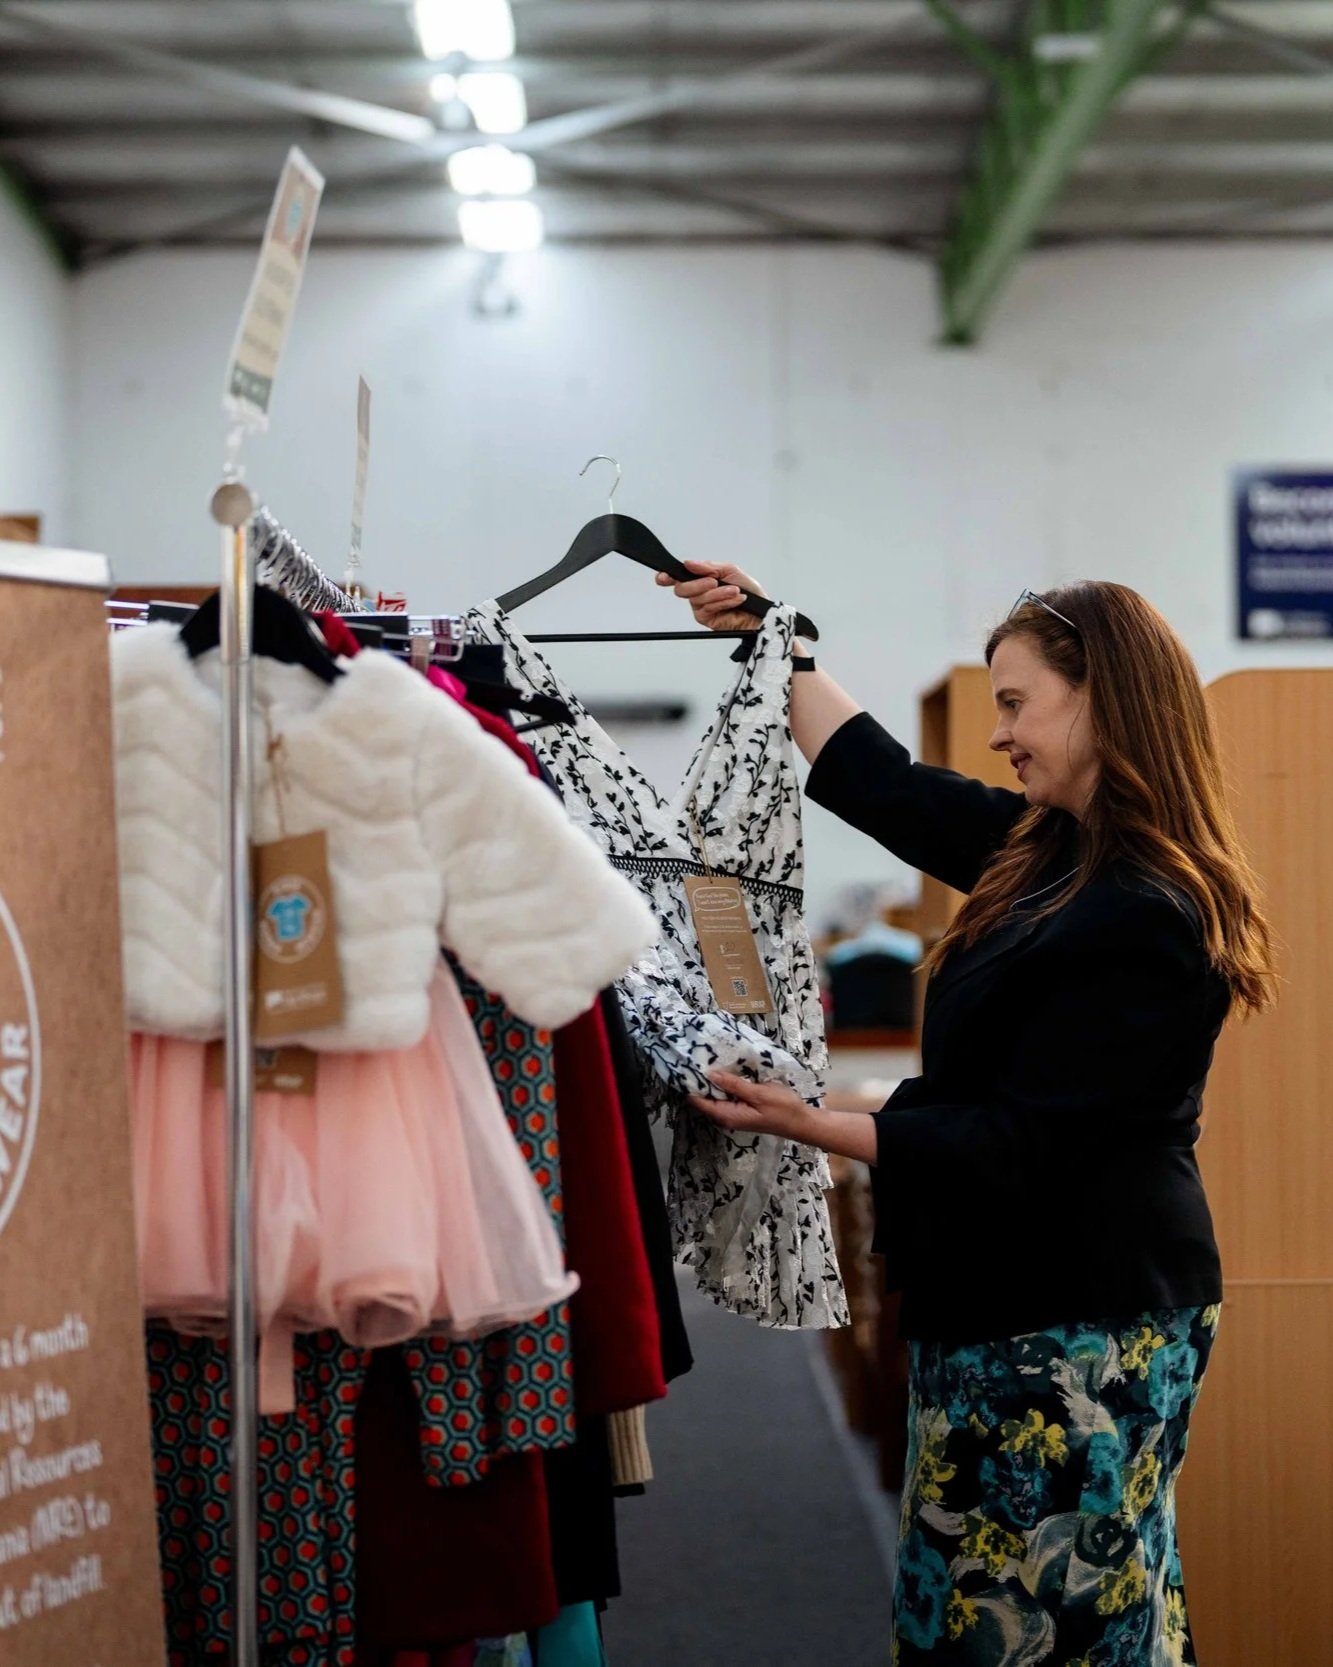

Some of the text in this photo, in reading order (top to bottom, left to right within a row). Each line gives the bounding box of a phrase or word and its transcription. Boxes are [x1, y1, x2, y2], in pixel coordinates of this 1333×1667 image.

[30, 1312, 89, 1360] month
[34, 1380, 70, 1422] the
[85, 1492, 111, 1531] to
